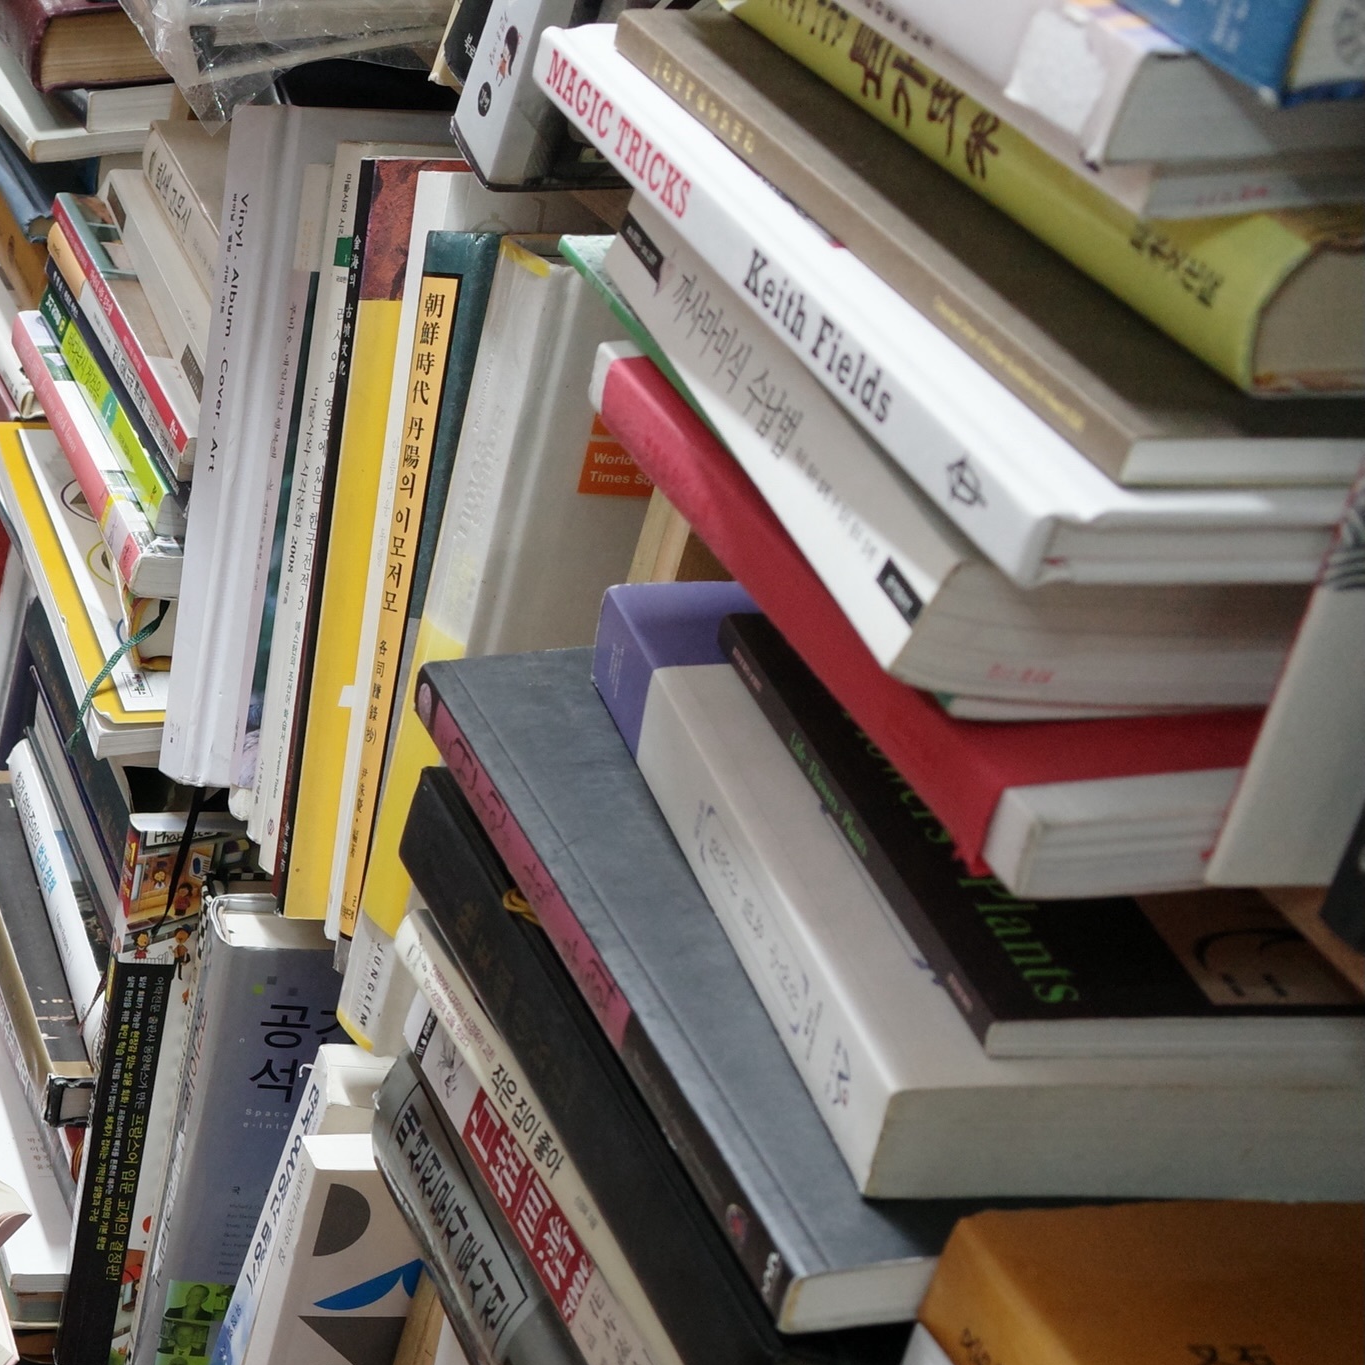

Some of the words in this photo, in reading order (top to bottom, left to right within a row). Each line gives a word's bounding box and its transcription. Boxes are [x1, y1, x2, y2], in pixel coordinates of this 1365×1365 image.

[233, 192, 249, 248] Vinyl
[545, 49, 616, 141] MAGIC
[610, 118, 695, 220] TRICKS
[744, 250, 815, 340] Keith
[809, 318, 895, 425] Fields
[223, 268, 242, 337] Album
[411, 292, 443, 406] 朝鮮時代
[671, 274, 751, 394] 까사마미식
[743, 371, 806, 459] 수납법
[212, 358, 229, 420] Cover
[207, 438, 219, 474] Art
[400, 414, 425, 500] 丹陽의
[589, 470, 630, 483] Times
[593, 452, 641, 466] World
[285, 536, 299, 574] 2008
[381, 508, 411, 613] 이모저모
[358, 940, 385, 1027] JUNGLIM
[133, 1090, 147, 1110] 만든
[491, 1063, 519, 1111] 작은
[511, 1097, 542, 1145] 집이
[534, 1130, 566, 1181] 좋아
[123, 1112, 144, 1165] 프랑스어
[116, 1167, 136, 1195] 입문
[110, 1197, 131, 1236] 교재의
[102, 1239, 124, 1282] 결정판!
